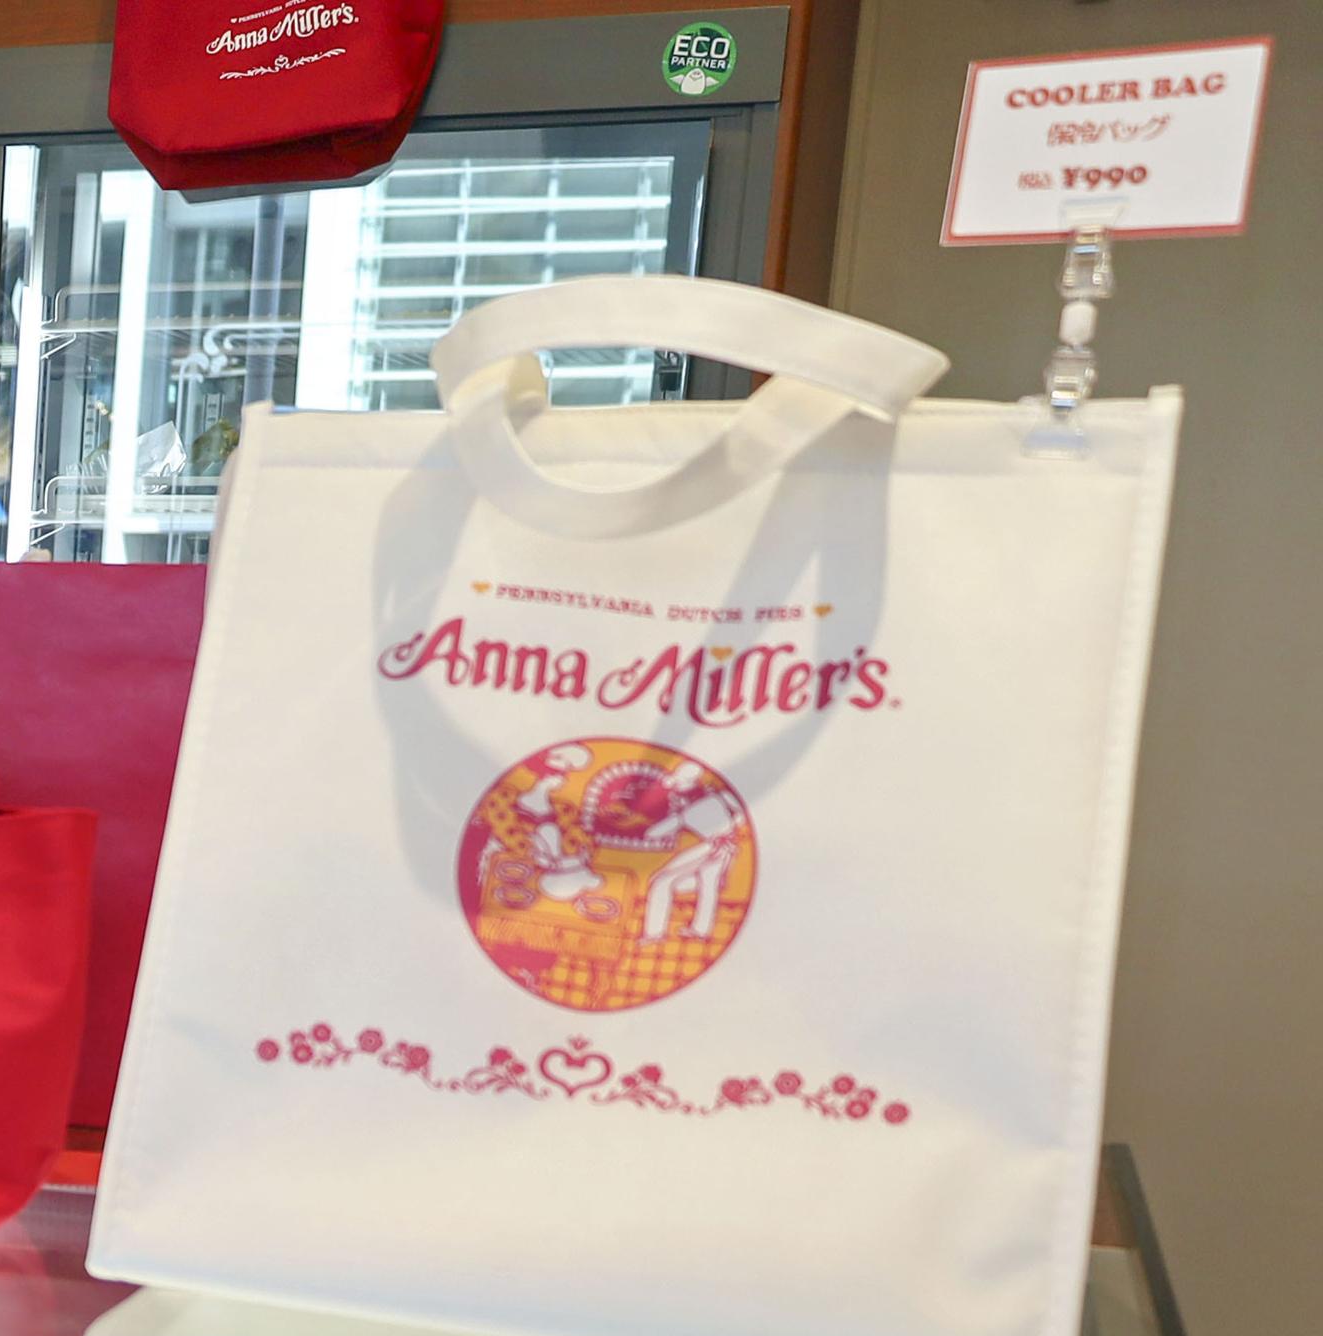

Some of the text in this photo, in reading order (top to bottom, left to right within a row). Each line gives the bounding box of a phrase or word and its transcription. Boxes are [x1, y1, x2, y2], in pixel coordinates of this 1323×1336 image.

[206, 27, 268, 54] Anna
[673, 35, 730, 58] ECO
[671, 57, 726, 69] PARTNER
[1005, 72, 1227, 109] COOLER BAG
[1062, 164, 1149, 190] ¥990
[378, 616, 888, 728] Anna Miller's
